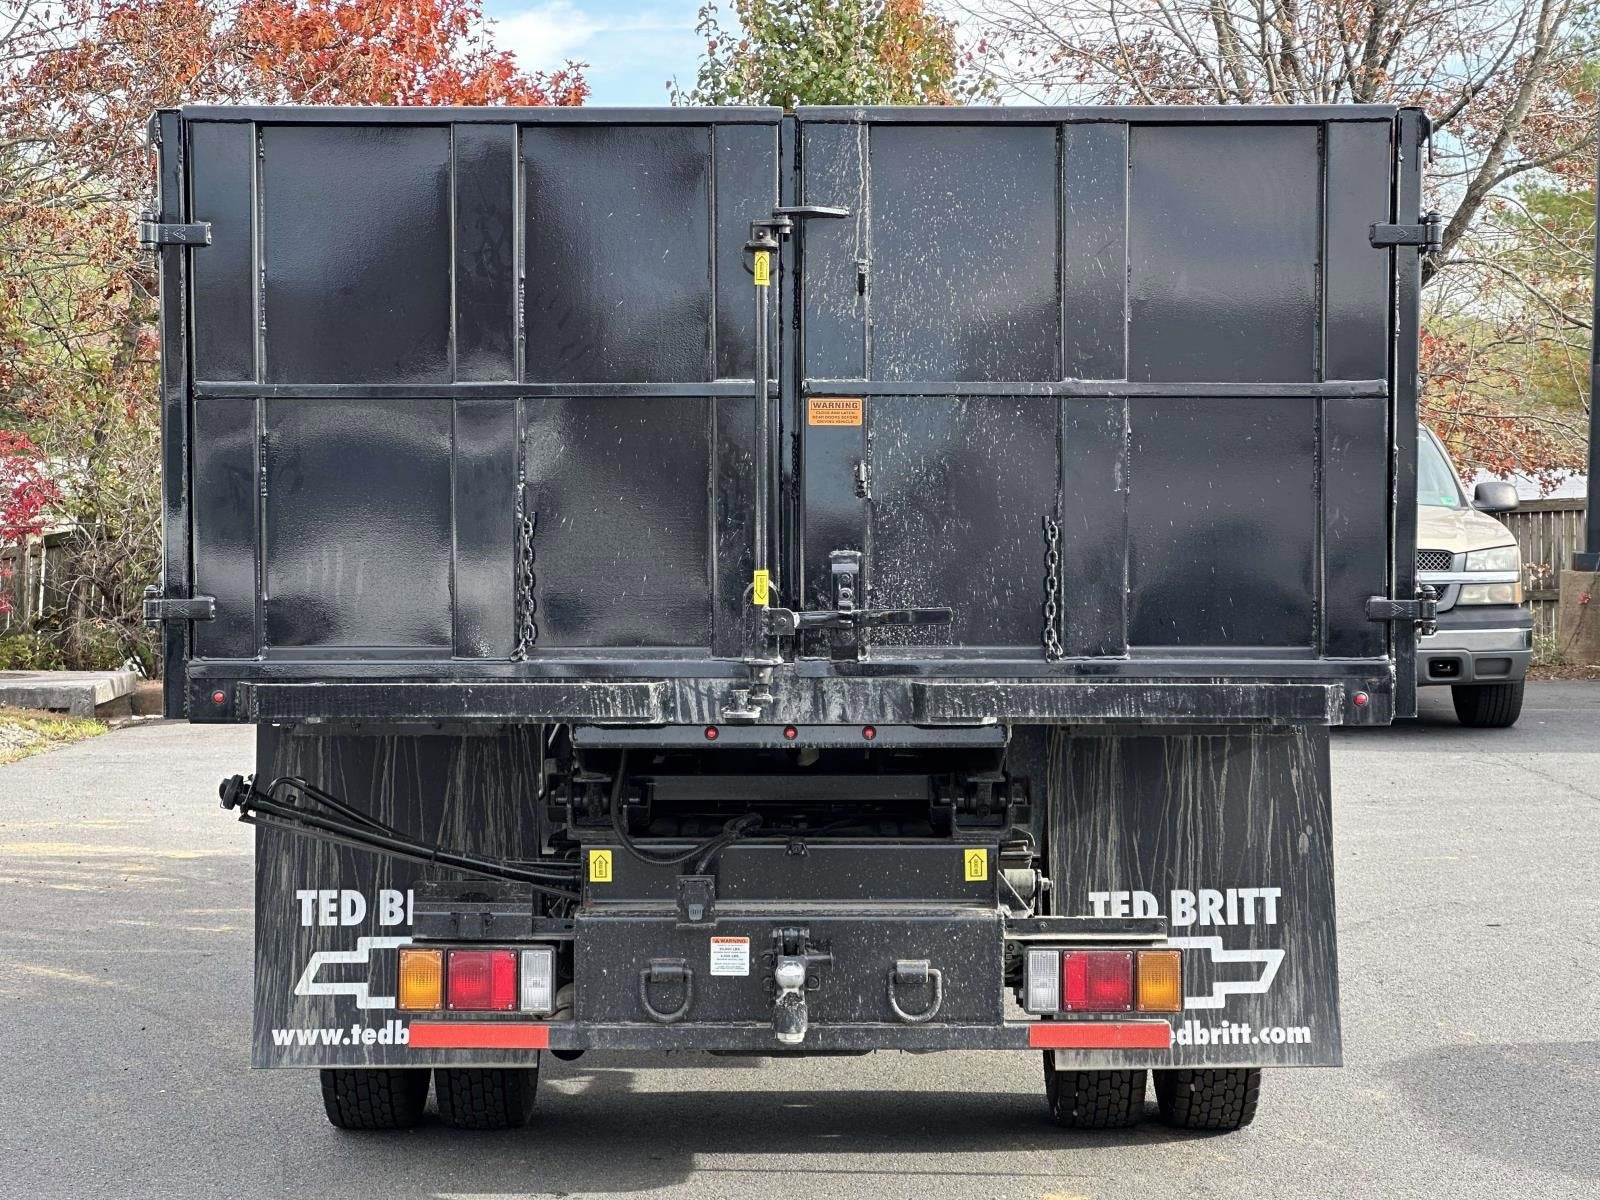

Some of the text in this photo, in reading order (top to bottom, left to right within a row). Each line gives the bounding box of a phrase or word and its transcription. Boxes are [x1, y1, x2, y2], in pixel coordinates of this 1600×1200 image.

[296, 889, 367, 926] TED
[1088, 887, 1282, 926] TED BRITT
[271, 1019, 410, 1046] www.tedb
